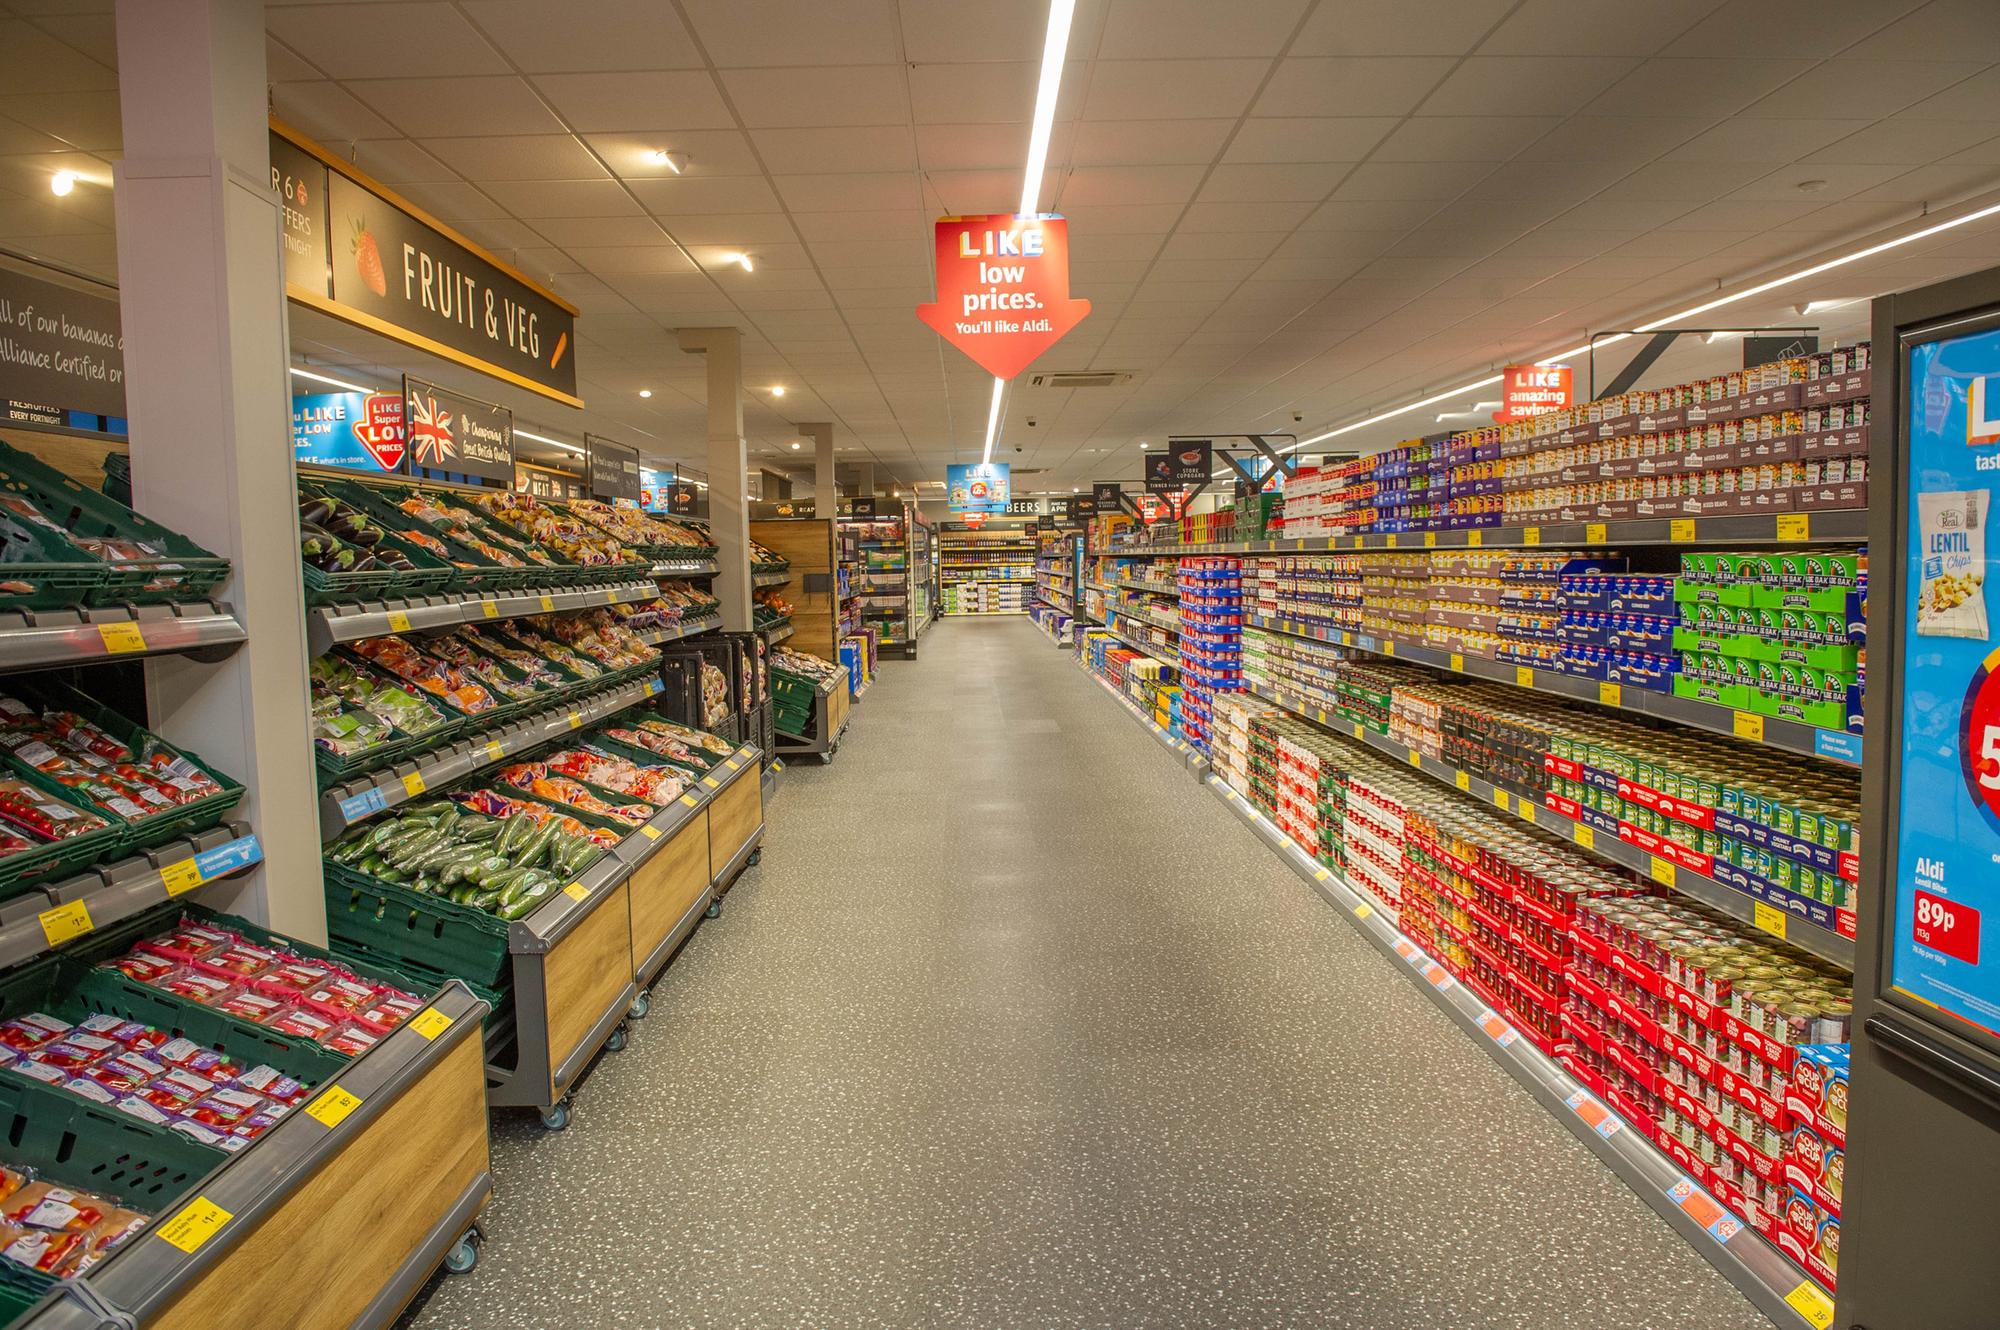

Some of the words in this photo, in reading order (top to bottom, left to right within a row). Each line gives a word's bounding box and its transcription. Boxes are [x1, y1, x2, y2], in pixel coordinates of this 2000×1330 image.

[284, 175, 294, 200] 6
[282, 204, 311, 236] FFERS
[284, 233, 312, 258] TNIGHT
[959, 229, 1044, 258] LIKE
[979, 262, 1025, 284] low
[403, 243, 476, 329] FRUIT
[484, 287, 499, 341] &
[504, 298, 540, 359] VEG
[963, 287, 1044, 317] prices.
[18, 305, 34, 333] of
[37, 315, 59, 334] our
[62, 314, 114, 349] bananas
[955, 321, 991, 334] You'll
[995, 320, 1019, 333] like
[1022, 319, 1053, 332] Aldi.
[55, 351, 107, 381] Certified
[110, 368, 122, 383] or
[1515, 372, 1561, 388] LIKE
[1510, 389, 1566, 405] amazing
[10, 410, 29, 421] EVERY
[303, 406, 346, 423] LIKE
[373, 403, 401, 414] LIKE
[305, 423, 332, 435] LOW
[374, 415, 401, 426] Super
[376, 444, 404, 452] PRICES
[1006, 502, 1041, 513] BEERS
[1930, 532, 1970, 553] LENTIL
[1947, 554, 1972, 569] Chips
[1845, 857, 1859, 866] CARRO
[1915, 857, 1945, 882] Aldi
[1918, 898, 1955, 933] 89p
[1799, 1063, 1820, 1082] SOUP
[1804, 1077, 1820, 1093] CUP
[1817, 1117, 1846, 1142] INSTANT
[1800, 1132, 1821, 1152] SOUP
[1804, 1147, 1821, 1163] CUP
[1832, 1156, 1844, 1171] SO
[1816, 1188, 1841, 1211] INSTAN
[1793, 1202, 1814, 1221] SOUP
[1799, 1216, 1814, 1233] CUP
[1808, 1256, 1837, 1285] INSTANT
